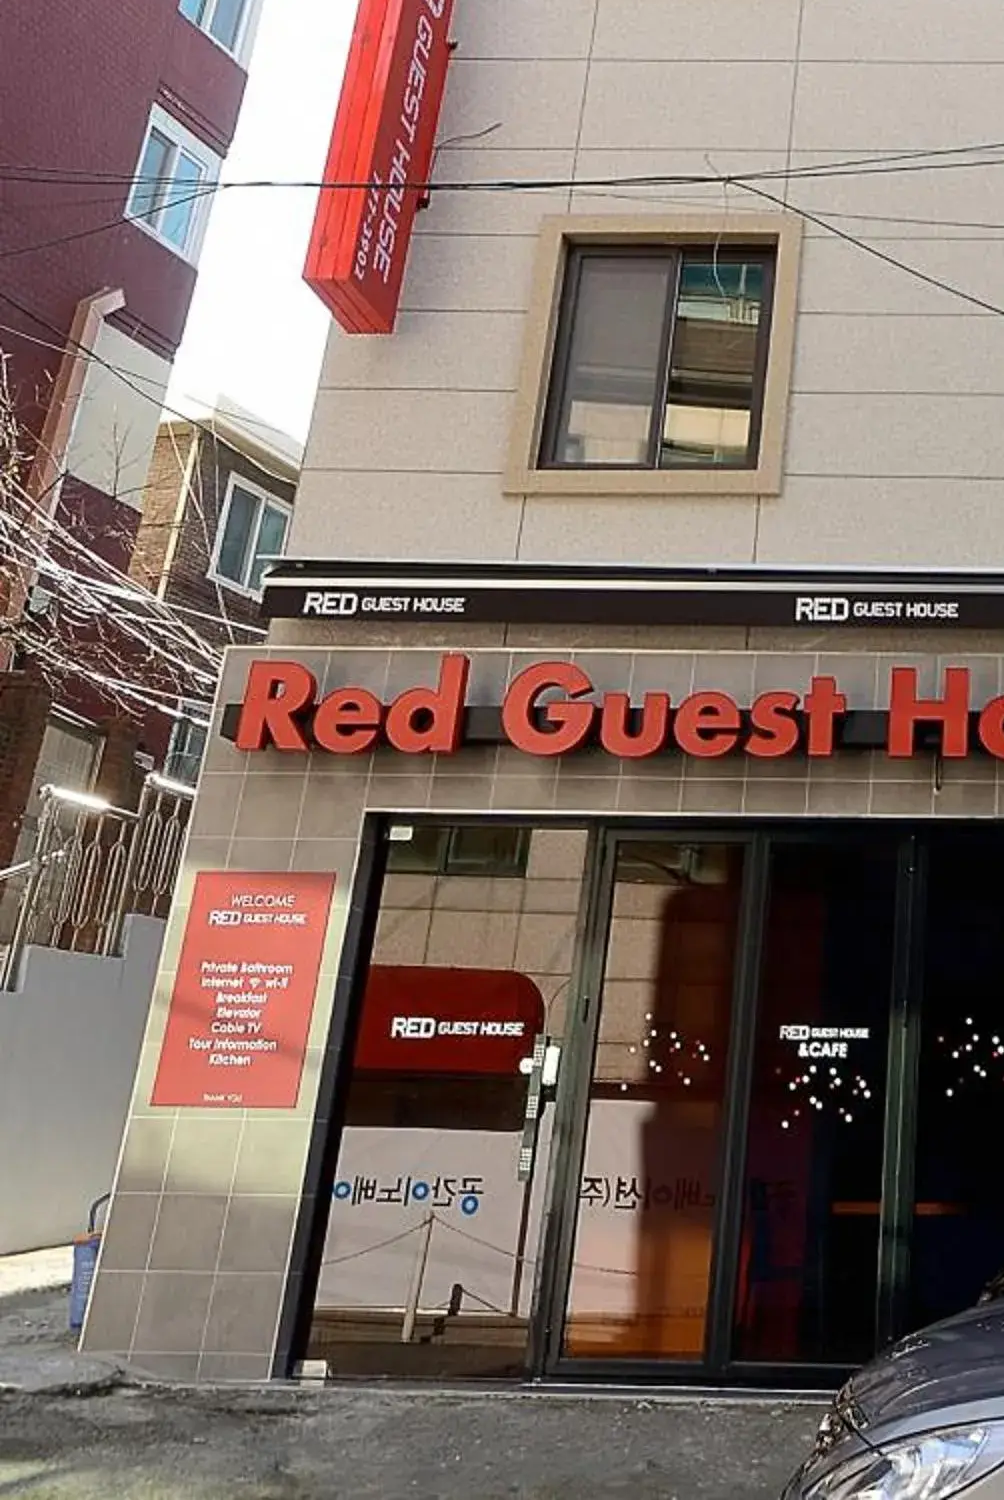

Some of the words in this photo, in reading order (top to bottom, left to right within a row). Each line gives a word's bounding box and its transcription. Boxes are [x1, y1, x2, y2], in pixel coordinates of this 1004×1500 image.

[400, 14, 433, 143] GUEST
[372, 138, 411, 284] HOUSE
[302, 593, 357, 615] RED
[361, 597, 409, 613] GUEST
[412, 597, 465, 613] HOUSE
[795, 597, 848, 622] RED
[853, 602, 901, 618] GUEST
[905, 602, 958, 618] HOUSE
[235, 652, 471, 757] Red
[501, 658, 847, 760] Guest
[231, 894, 296, 908] WELCOME
[208, 911, 241, 926] RED
[201, 961, 238, 973] Private
[240, 961, 293, 974] Bathroom
[201, 976, 244, 988] Internet
[216, 991, 268, 1004] Breakfast
[216, 1006, 262, 1019] Elevator
[211, 1021, 245, 1034] Cable
[247, 1022, 262, 1033] TV
[390, 1017, 435, 1038] RED
[437, 1021, 480, 1036] GUEST
[481, 1021, 525, 1036] HOUSE
[779, 1025, 809, 1040] RED
[189, 1036, 212, 1049] Tour
[213, 1037, 278, 1051] Information
[798, 1042, 848, 1058] &CAFE
[209, 1053, 251, 1066] Kitchen
